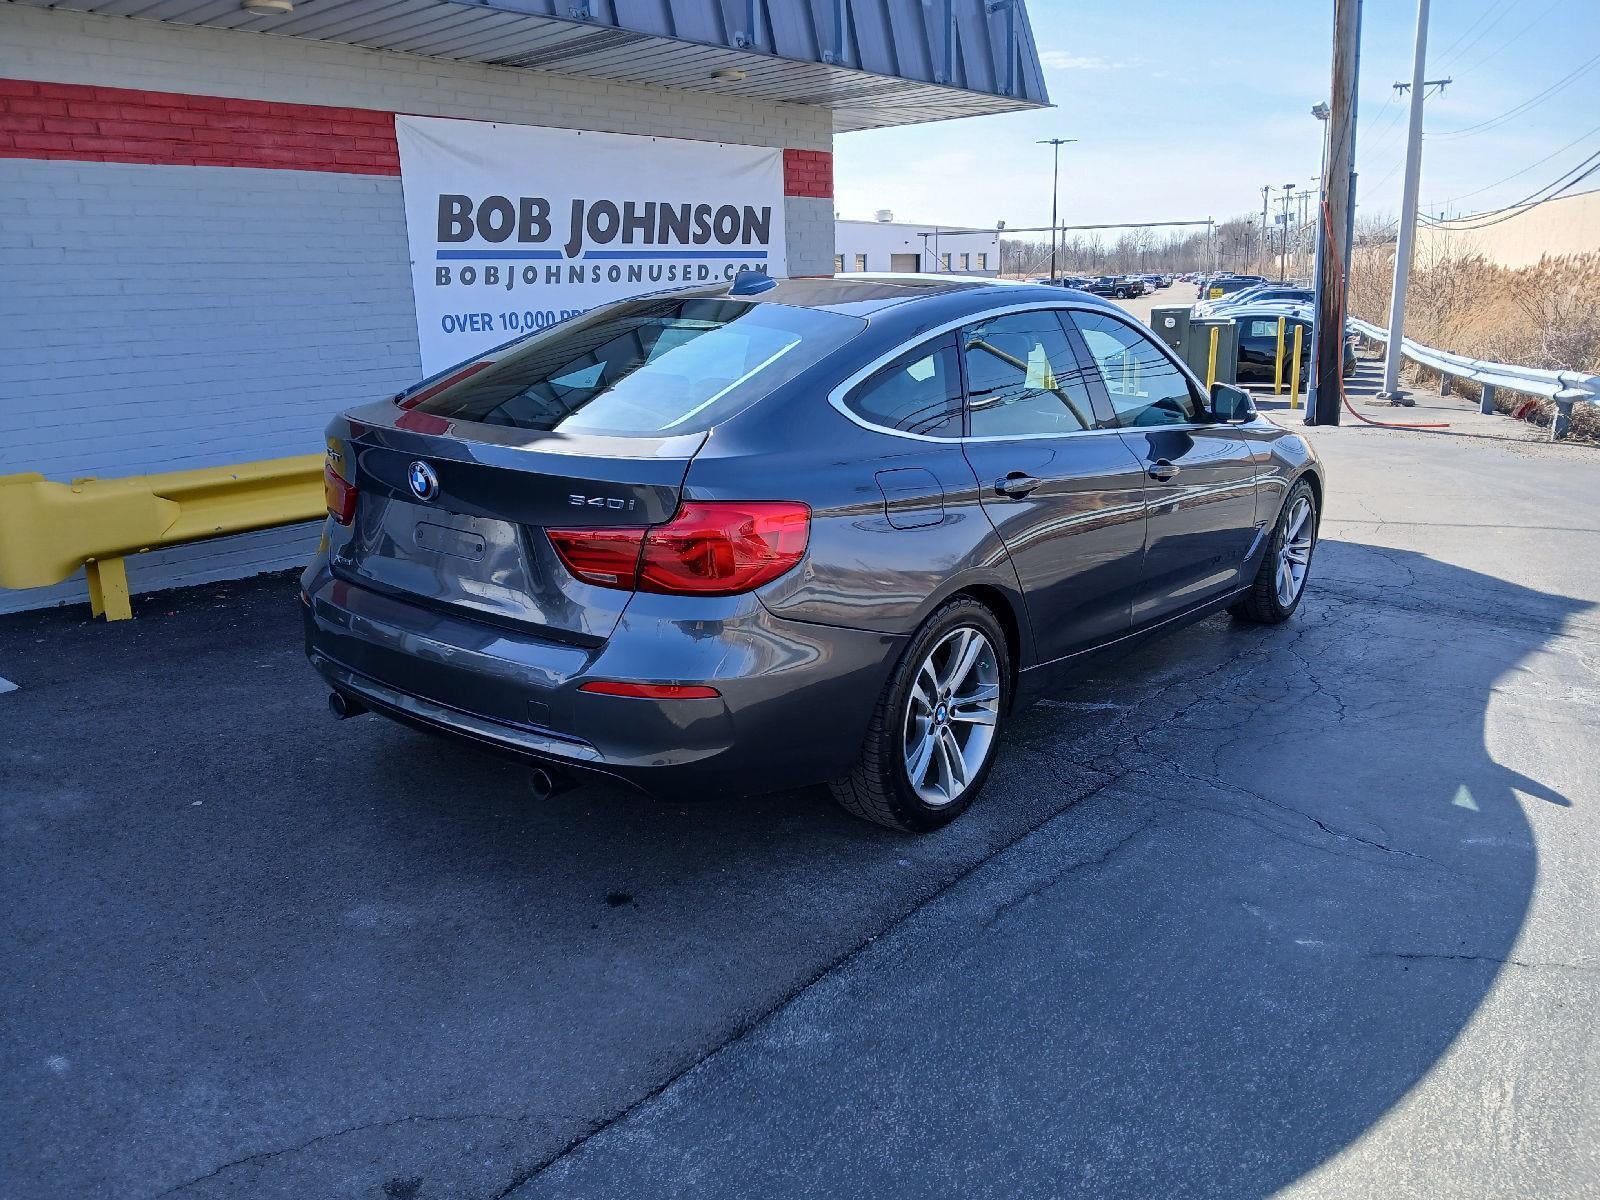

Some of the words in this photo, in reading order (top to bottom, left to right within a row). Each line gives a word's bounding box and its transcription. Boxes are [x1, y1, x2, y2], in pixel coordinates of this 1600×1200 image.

[437, 194, 551, 243] BOB
[564, 199, 771, 258] JOHNSON
[441, 312, 494, 334] OVER
[498, 310, 556, 333] 10,000
